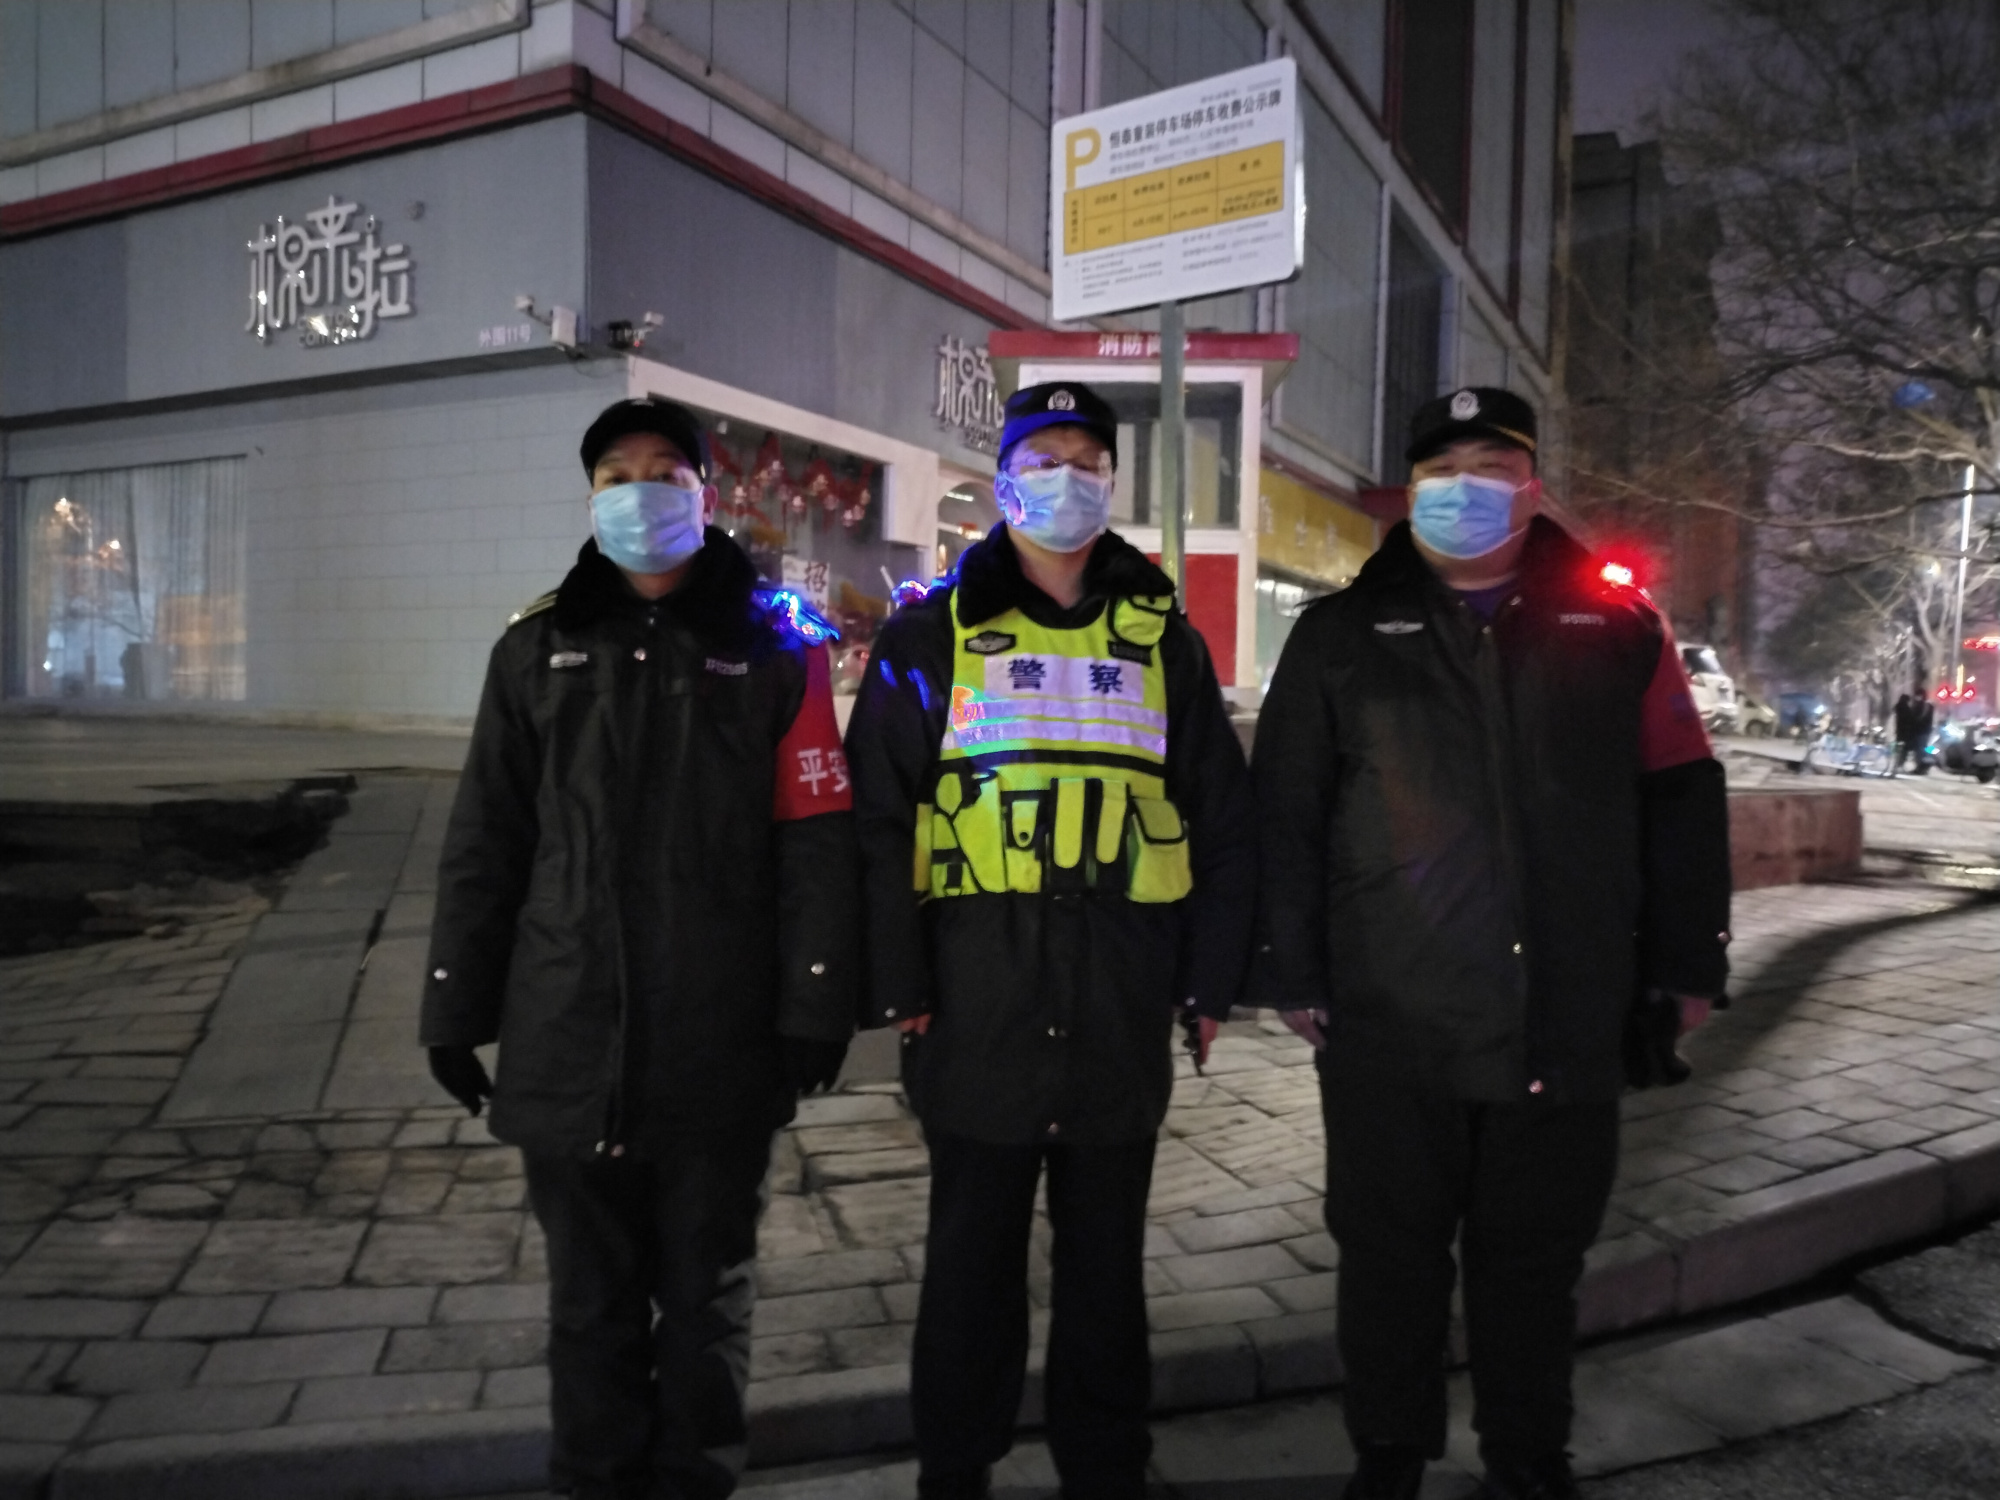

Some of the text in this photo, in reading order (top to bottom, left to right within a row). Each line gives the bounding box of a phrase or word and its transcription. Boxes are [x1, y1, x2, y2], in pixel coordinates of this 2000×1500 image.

[1065, 127, 1102, 190] P
[1098, 333, 1191, 357] 消防岗
[1007, 658, 1124, 694] 警察
